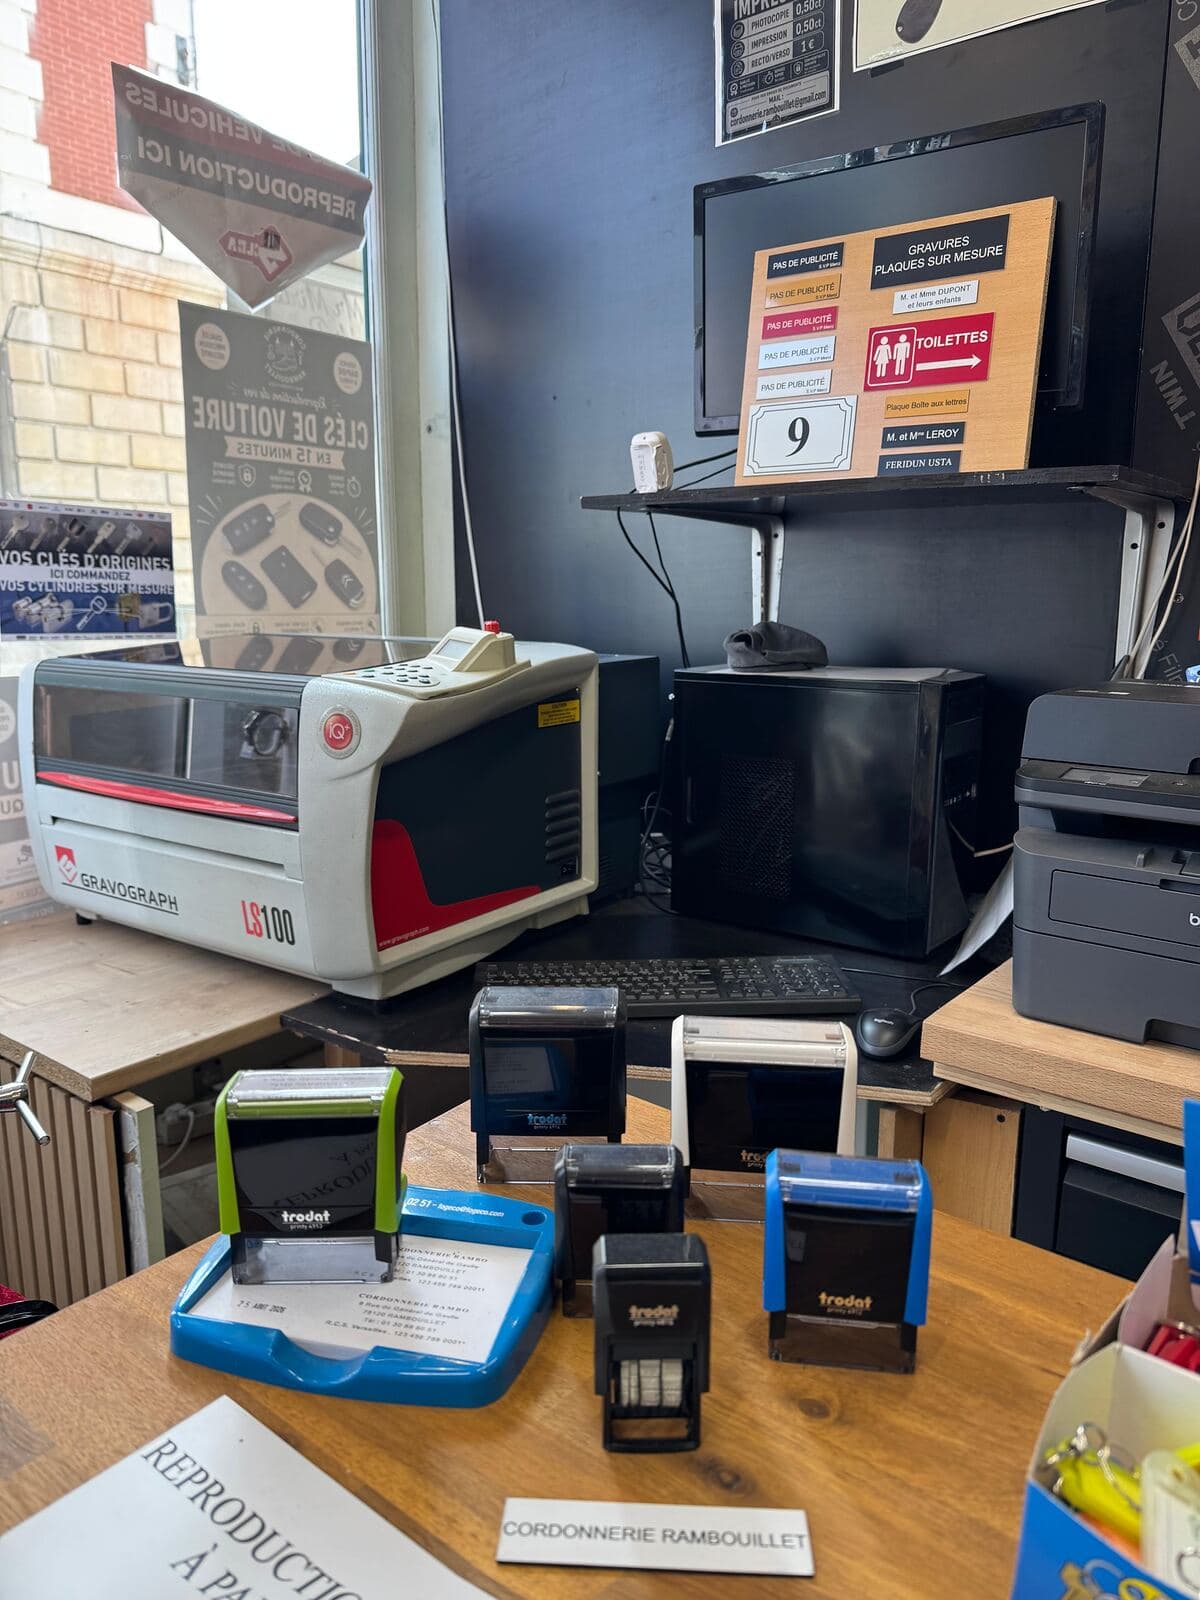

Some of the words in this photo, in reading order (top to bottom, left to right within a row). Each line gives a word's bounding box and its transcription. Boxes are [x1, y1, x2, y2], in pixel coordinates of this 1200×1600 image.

[751, 8, 791, 31] PHOTOCOPIE
[751, 29, 789, 50] IMPRESSION
[795, 17, 822, 36] 0,50ct
[751, 47, 791, 67] RECTO/VERSO
[730, 91, 827, 127] cordonnerie.rambouillet@gmail.com
[908, 235, 970, 256] GRAVURES
[772, 261, 788, 270] PAS
[788, 259, 799, 267] DE
[800, 251, 839, 266] PUBLICITÉ
[874, 258, 925, 276] PLAQUES
[927, 253, 951, 267] SUR
[953, 244, 1004, 263] MESURE
[770, 291, 784, 300] PAS
[785, 289, 797, 298] DE
[796, 282, 836, 296] PUBLICITÉ
[900, 293, 909, 301] M.
[919, 290, 937, 299] Mme
[937, 284, 972, 296] DUPONT
[907, 302, 916, 310] et
[916, 299, 934, 308] leurs
[934, 295, 962, 306] enfants
[766, 321, 782, 331] PAS
[782, 319, 793, 328] DE
[793, 313, 833, 327] PUBLICITÉ
[916, 330, 989, 350] TOILETTES
[764, 352, 778, 361] PAS
[779, 350, 790, 359] DE
[791, 344, 829, 358] PUBLICITÉ
[760, 383, 775, 392] PAS
[775, 382, 787, 390] DE
[787, 376, 825, 389] PUBLICITÉ
[1149, 359, 1196, 430] TWIN
[886, 403, 910, 412] Plaque
[945, 398, 967, 406] lettres
[785, 416, 810, 457] 9
[886, 433, 897, 442] M.
[899, 432, 908, 441] et
[926, 428, 960, 439] LEROY
[885, 459, 926, 469] FERIDUN
[928, 457, 953, 467] USTA
[0, 550, 32, 566] VOS
[36, 547, 80, 568] CLÉS
[84, 554, 171, 571] D'ORIGINES
[50, 569, 65, 579] ICI
[67, 569, 131, 581] COMMANDEZ
[28, 581, 99, 594] CYLINDRES
[101, 583, 126, 595] SUR
[128, 584, 175, 596] MESURE
[80, 873, 179, 912] GRAVOGRAPH
[241, 899, 296, 946] LS100
[528, 1113, 568, 1124] trodat
[420, 1199, 431, 1208] 51
[281, 1210, 331, 1223] trodat
[411, 1263, 467, 1275] RAMBOUILLET
[358, 1292, 429, 1308] CORDONNERIE
[818, 1291, 873, 1310] trodat
[362, 1309, 386, 1318] 78120
[387, 1312, 447, 1326] RAMBOUILLET
[629, 1304, 679, 1319] trodat
[503, 1520, 656, 1543] CORDONNERIE
[662, 1527, 806, 1549] RAMBOUILLET
[169, 1542, 219, 1582] À
